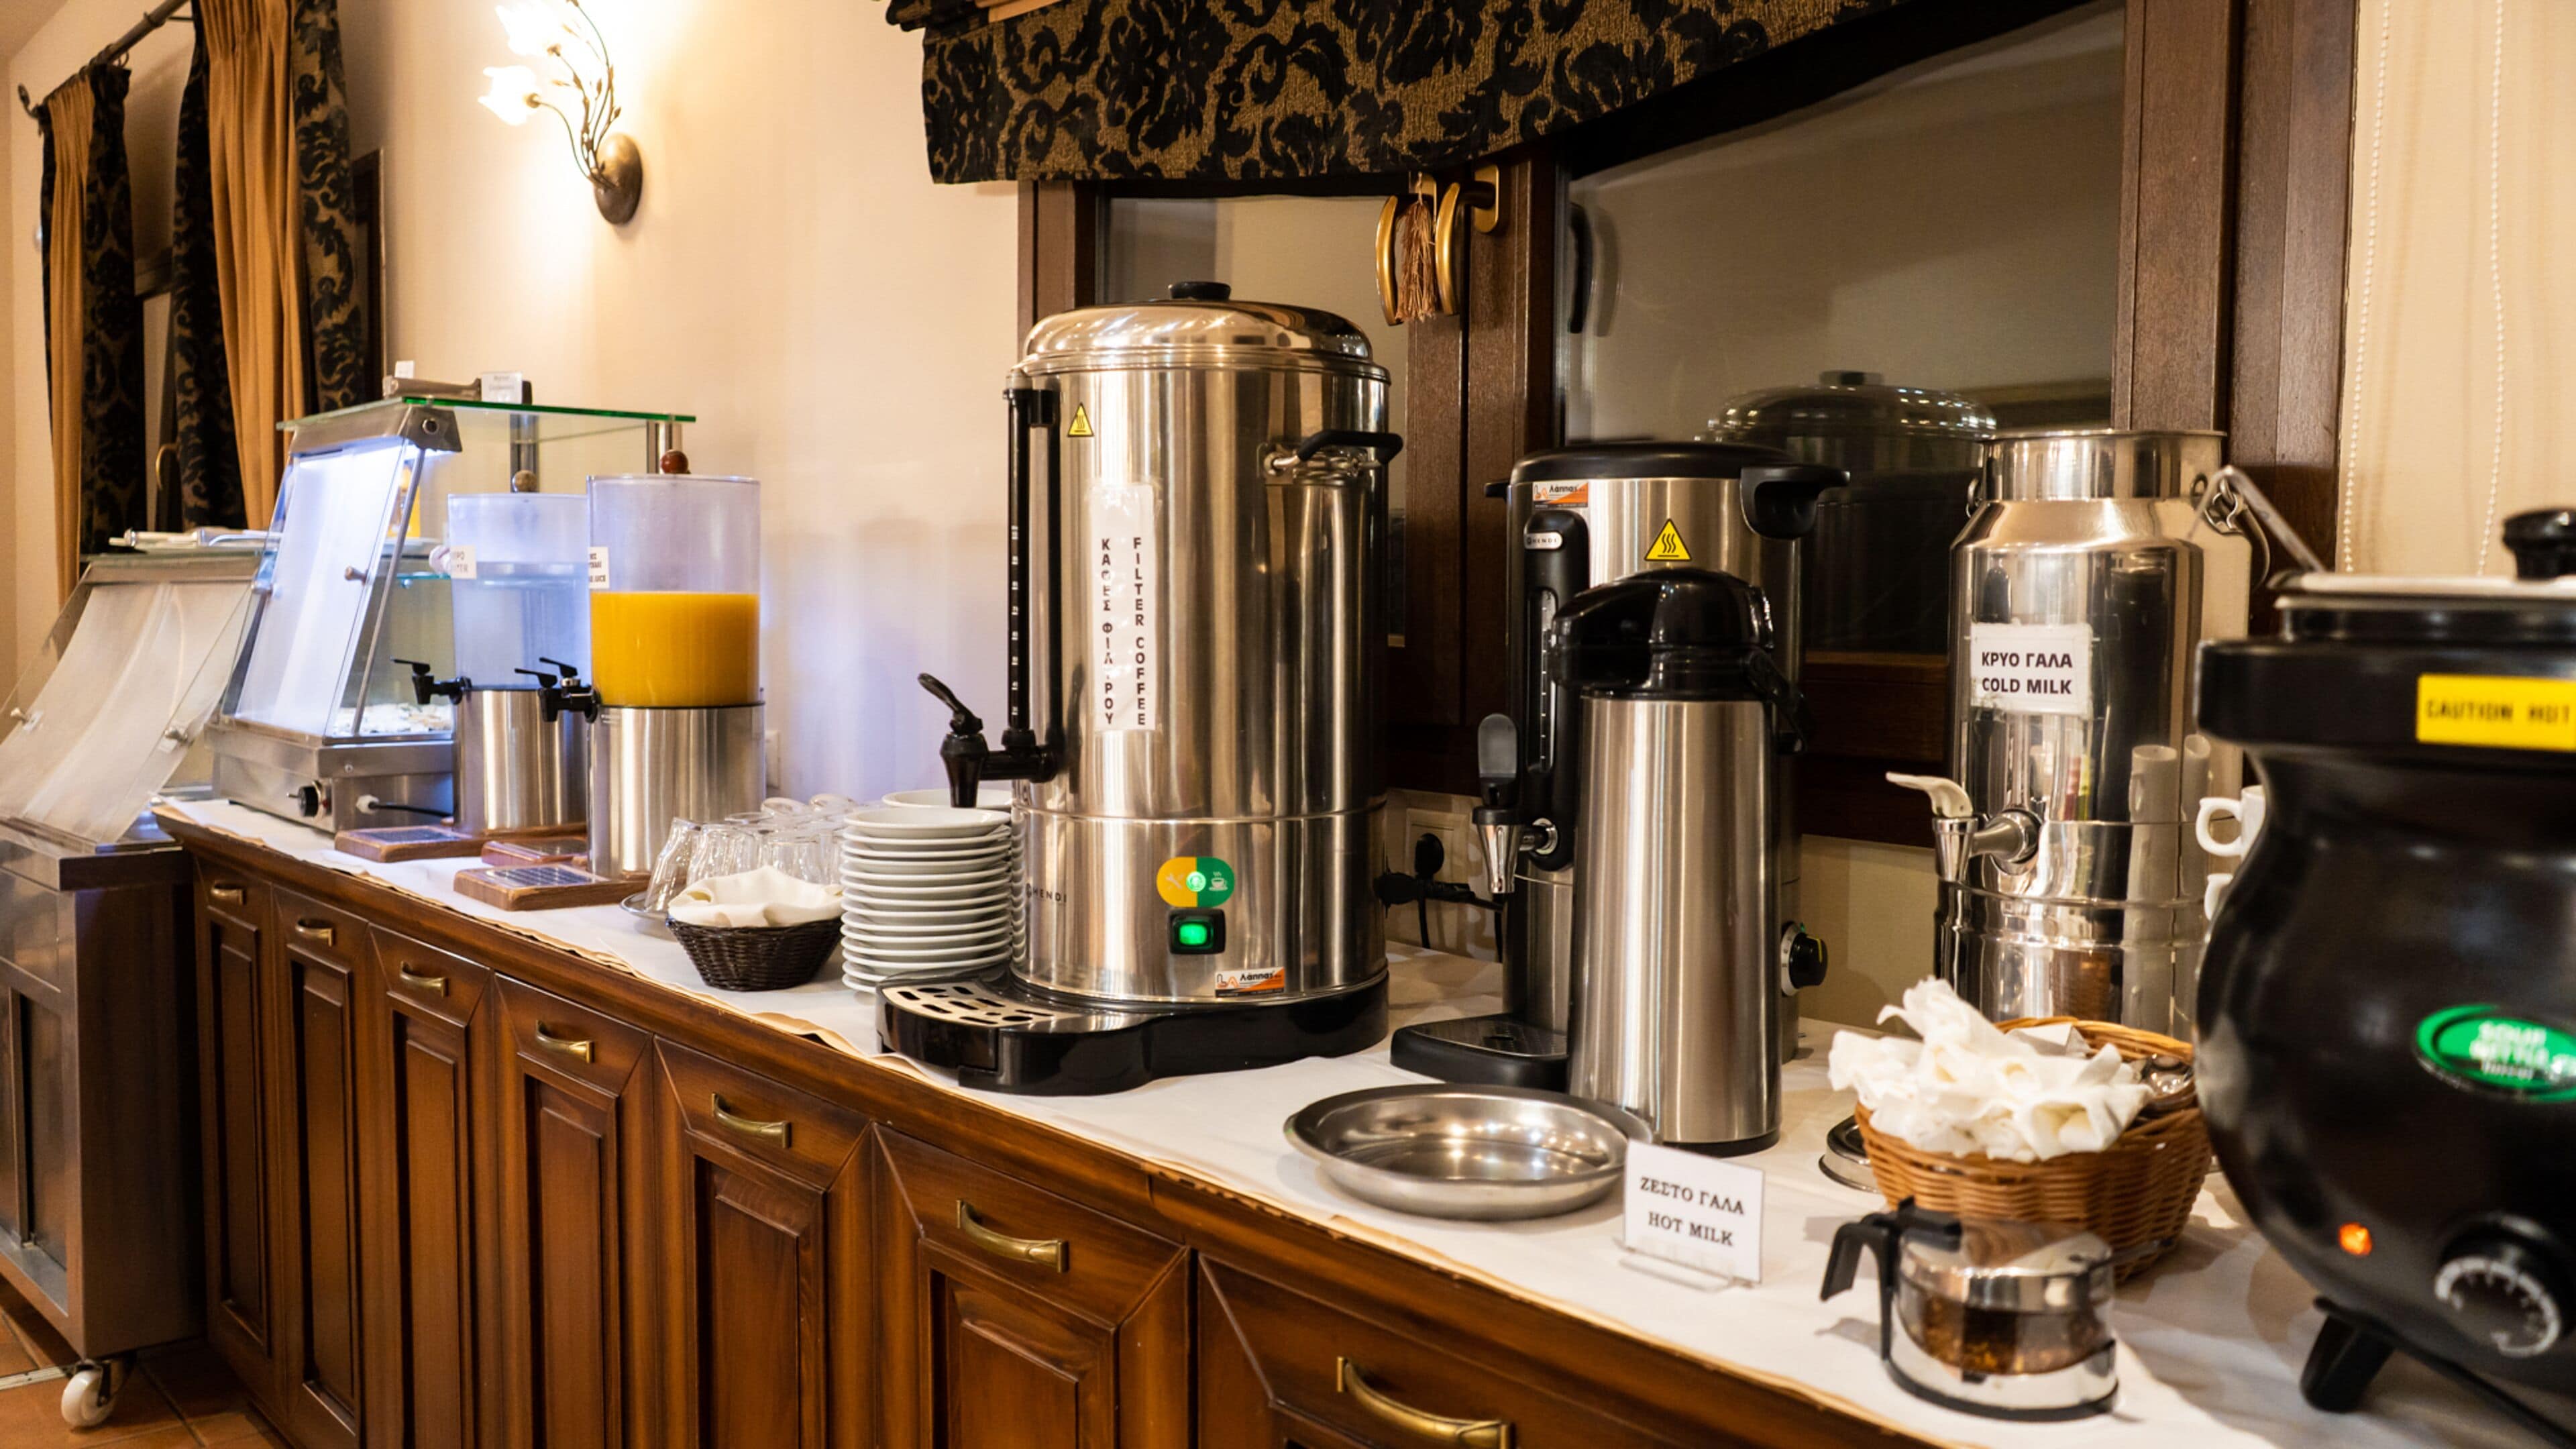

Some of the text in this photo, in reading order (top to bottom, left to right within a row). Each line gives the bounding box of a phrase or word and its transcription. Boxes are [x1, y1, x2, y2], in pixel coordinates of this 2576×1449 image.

[1132, 537, 1146, 726] FILTER COFFEE
[1102, 622, 1114, 725] ΦΙΛΡΟΥ
[1982, 651, 2073, 668] ΚΡΥΟ ΓΑΛΑ
[1982, 678, 2072, 695] COLD MILK
[2426, 700, 2571, 724] CAUTION HOT
[1033, 887, 1067, 903] HENDI
[1640, 1177, 1745, 1215] ΖΕΣΤΟ ΓΑΛΑ
[1648, 1211, 1733, 1246] HOT MILK
